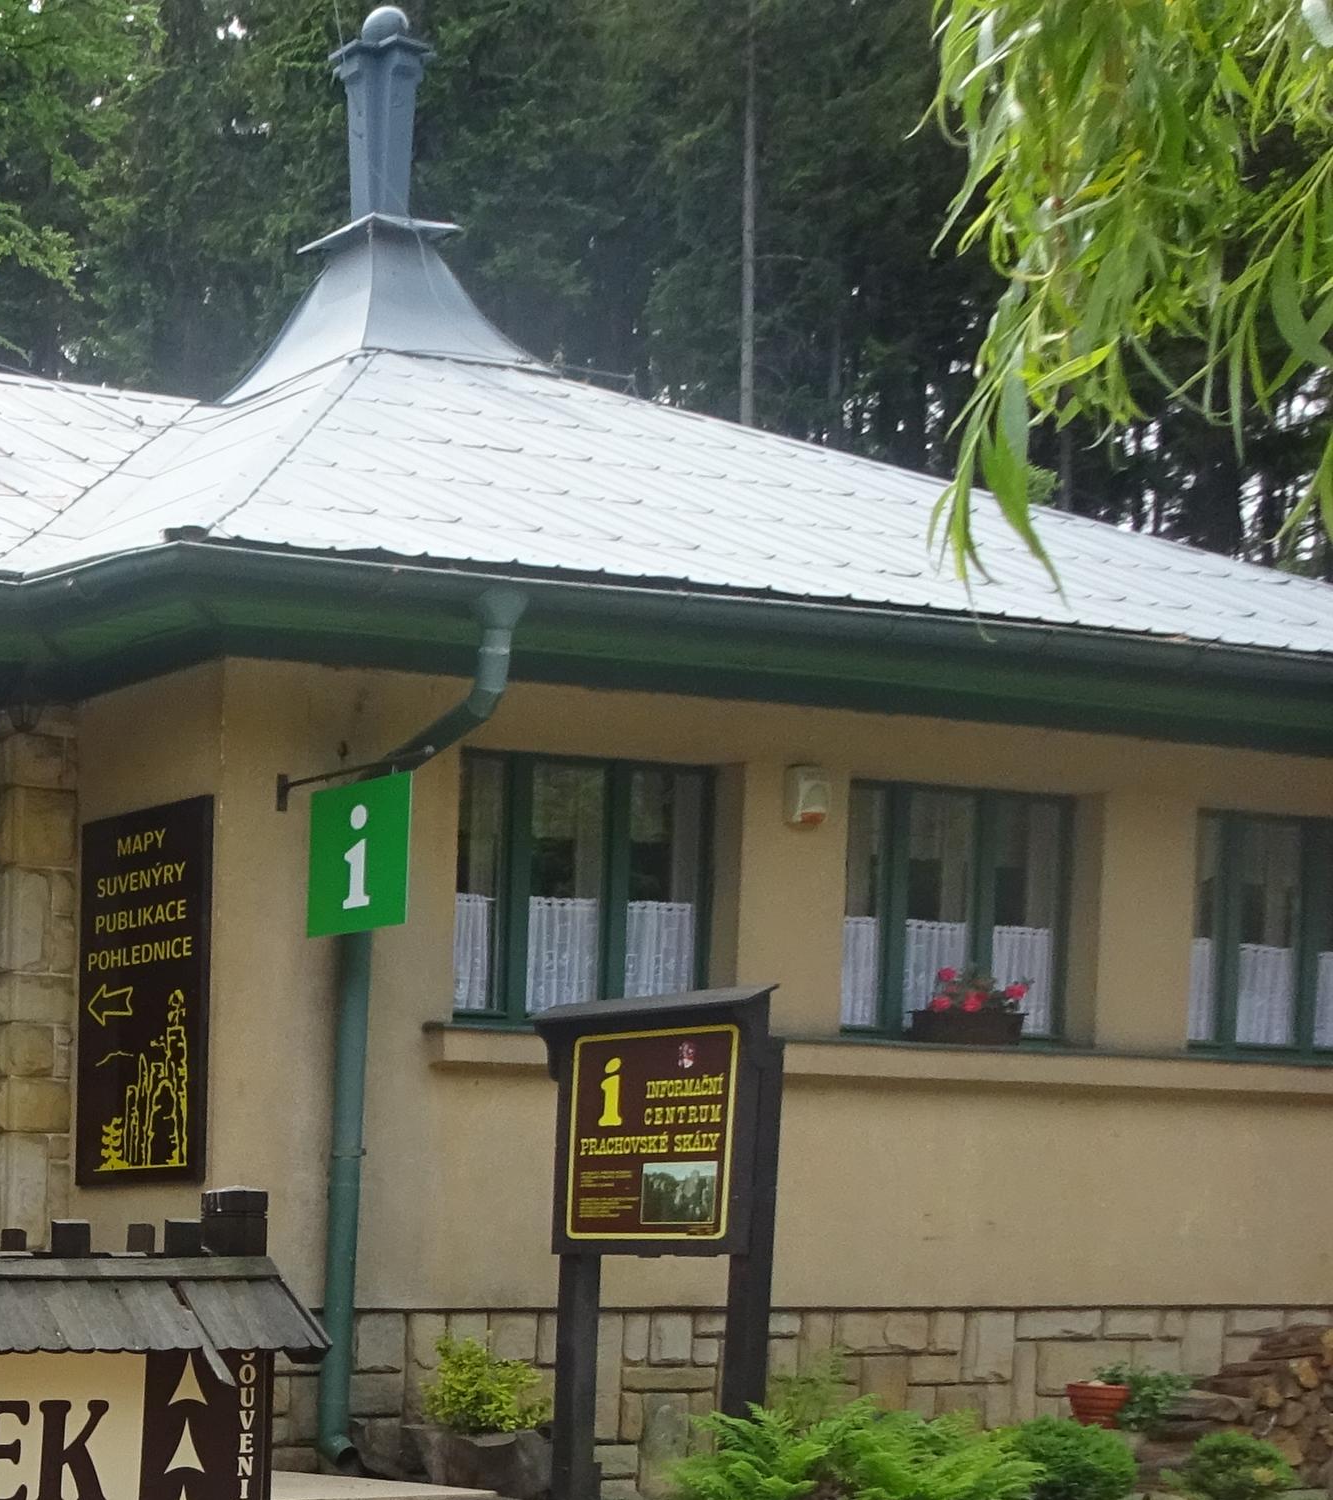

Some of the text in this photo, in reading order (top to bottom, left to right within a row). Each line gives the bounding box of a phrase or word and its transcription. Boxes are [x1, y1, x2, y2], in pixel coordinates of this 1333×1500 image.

[117, 828, 166, 857] MAPY
[97, 861, 186, 898] SUVENÝRY
[95, 899, 187, 934] PUBLIKACE
[88, 936, 192, 972] POHLEDNICE
[645, 1073, 725, 1099] INFORMAČNÍ
[644, 1104, 721, 1126] CENTRUM
[579, 1130, 721, 1156] PRACHOVSKÉ SKÁLY
